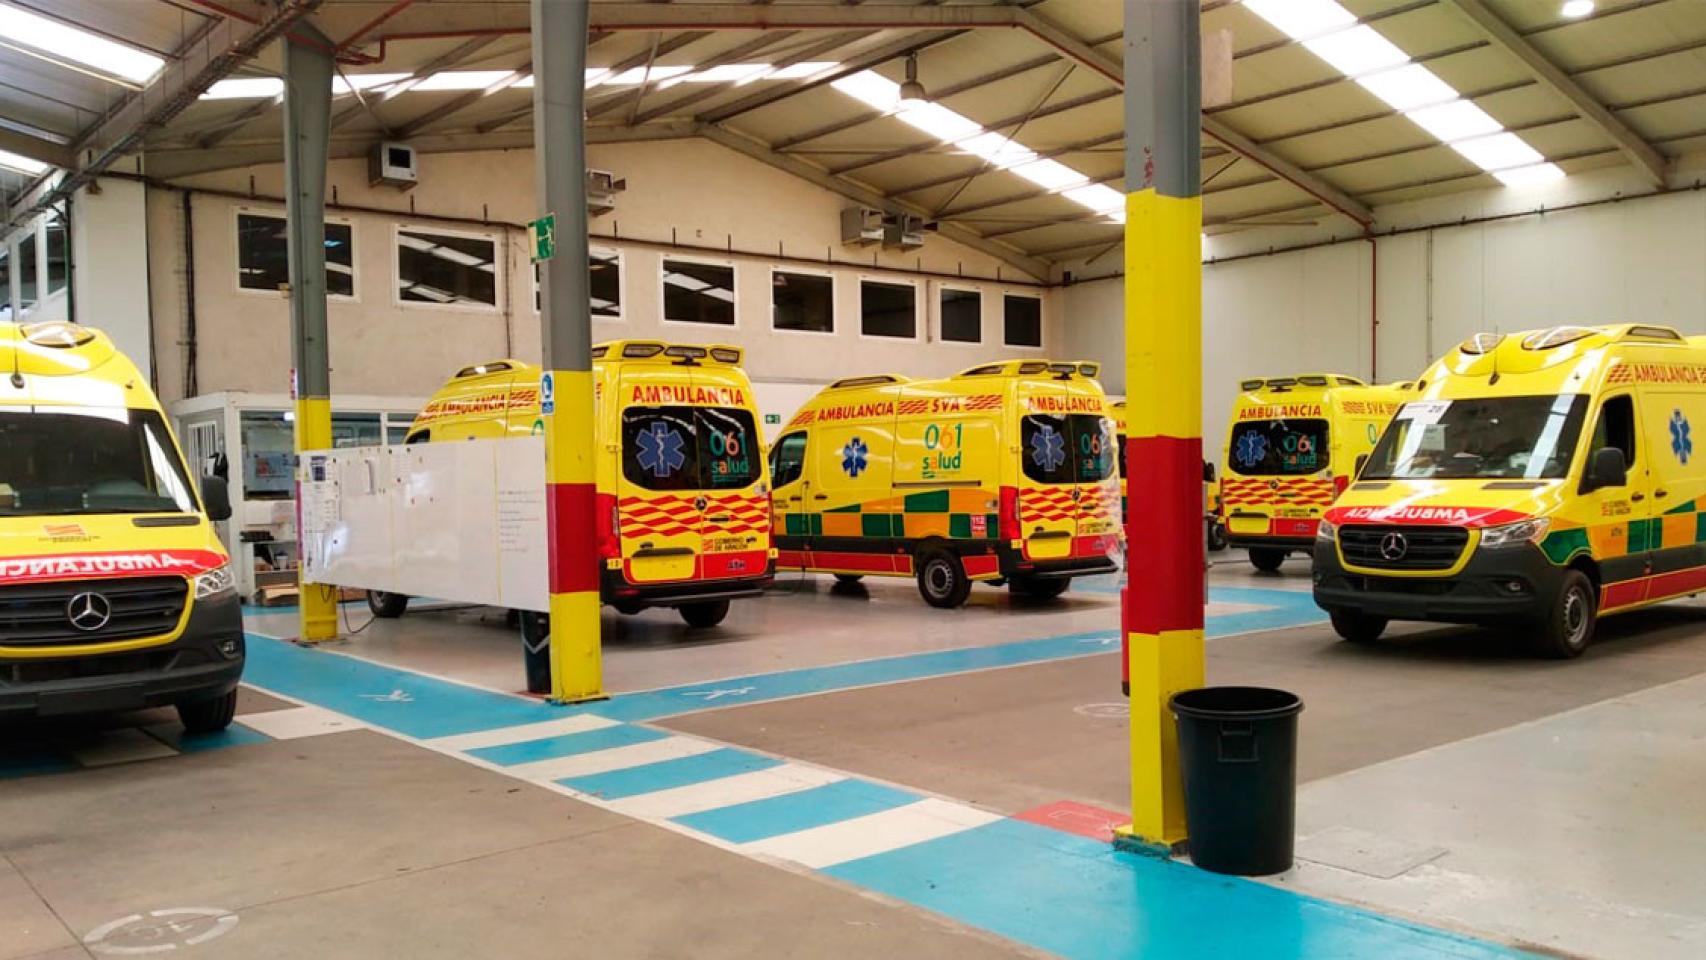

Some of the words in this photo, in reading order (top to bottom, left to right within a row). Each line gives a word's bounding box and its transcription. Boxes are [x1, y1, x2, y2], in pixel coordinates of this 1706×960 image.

[1635, 364, 1698, 384] AMBULANCIA
[632, 385, 746, 405] AMBULANCIA
[1028, 396, 1103, 411] AMBULANCIA
[817, 401, 894, 422] AMBULANCIA
[931, 398, 961, 413] SVA
[1239, 405, 1322, 420] AMBULANCIA
[709, 431, 746, 456] 061
[924, 423, 962, 450] 061
[1282, 433, 1317, 453] 061
[711, 456, 749, 474] salud
[922, 450, 962, 470] salud
